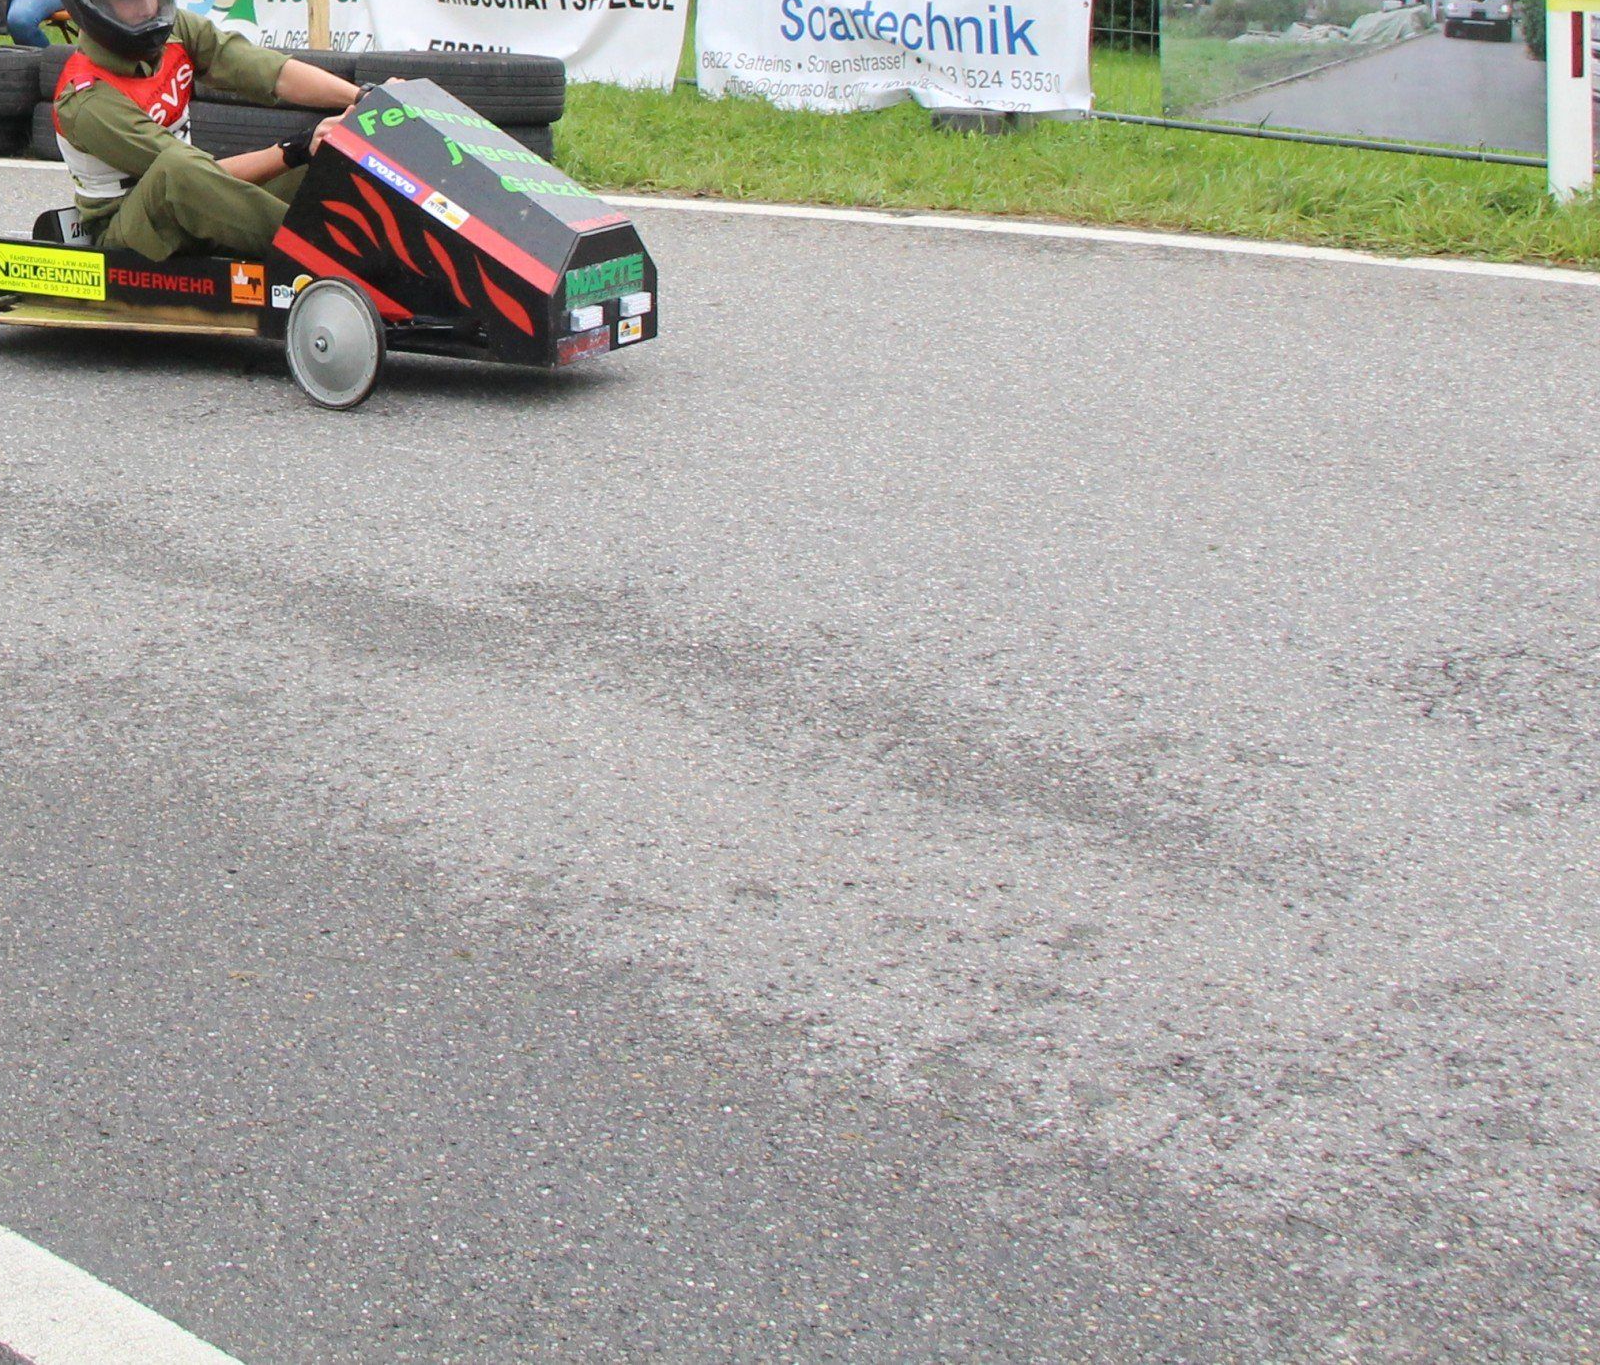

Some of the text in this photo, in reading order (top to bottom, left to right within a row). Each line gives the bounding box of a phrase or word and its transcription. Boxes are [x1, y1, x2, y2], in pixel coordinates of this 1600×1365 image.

[702, 51, 732, 69] 6822
[734, 52, 792, 73] Satteins
[149, 63, 194, 126] SVS
[368, 155, 416, 194] VOLVO
[108, 268, 215, 295] FEUERWEHR
